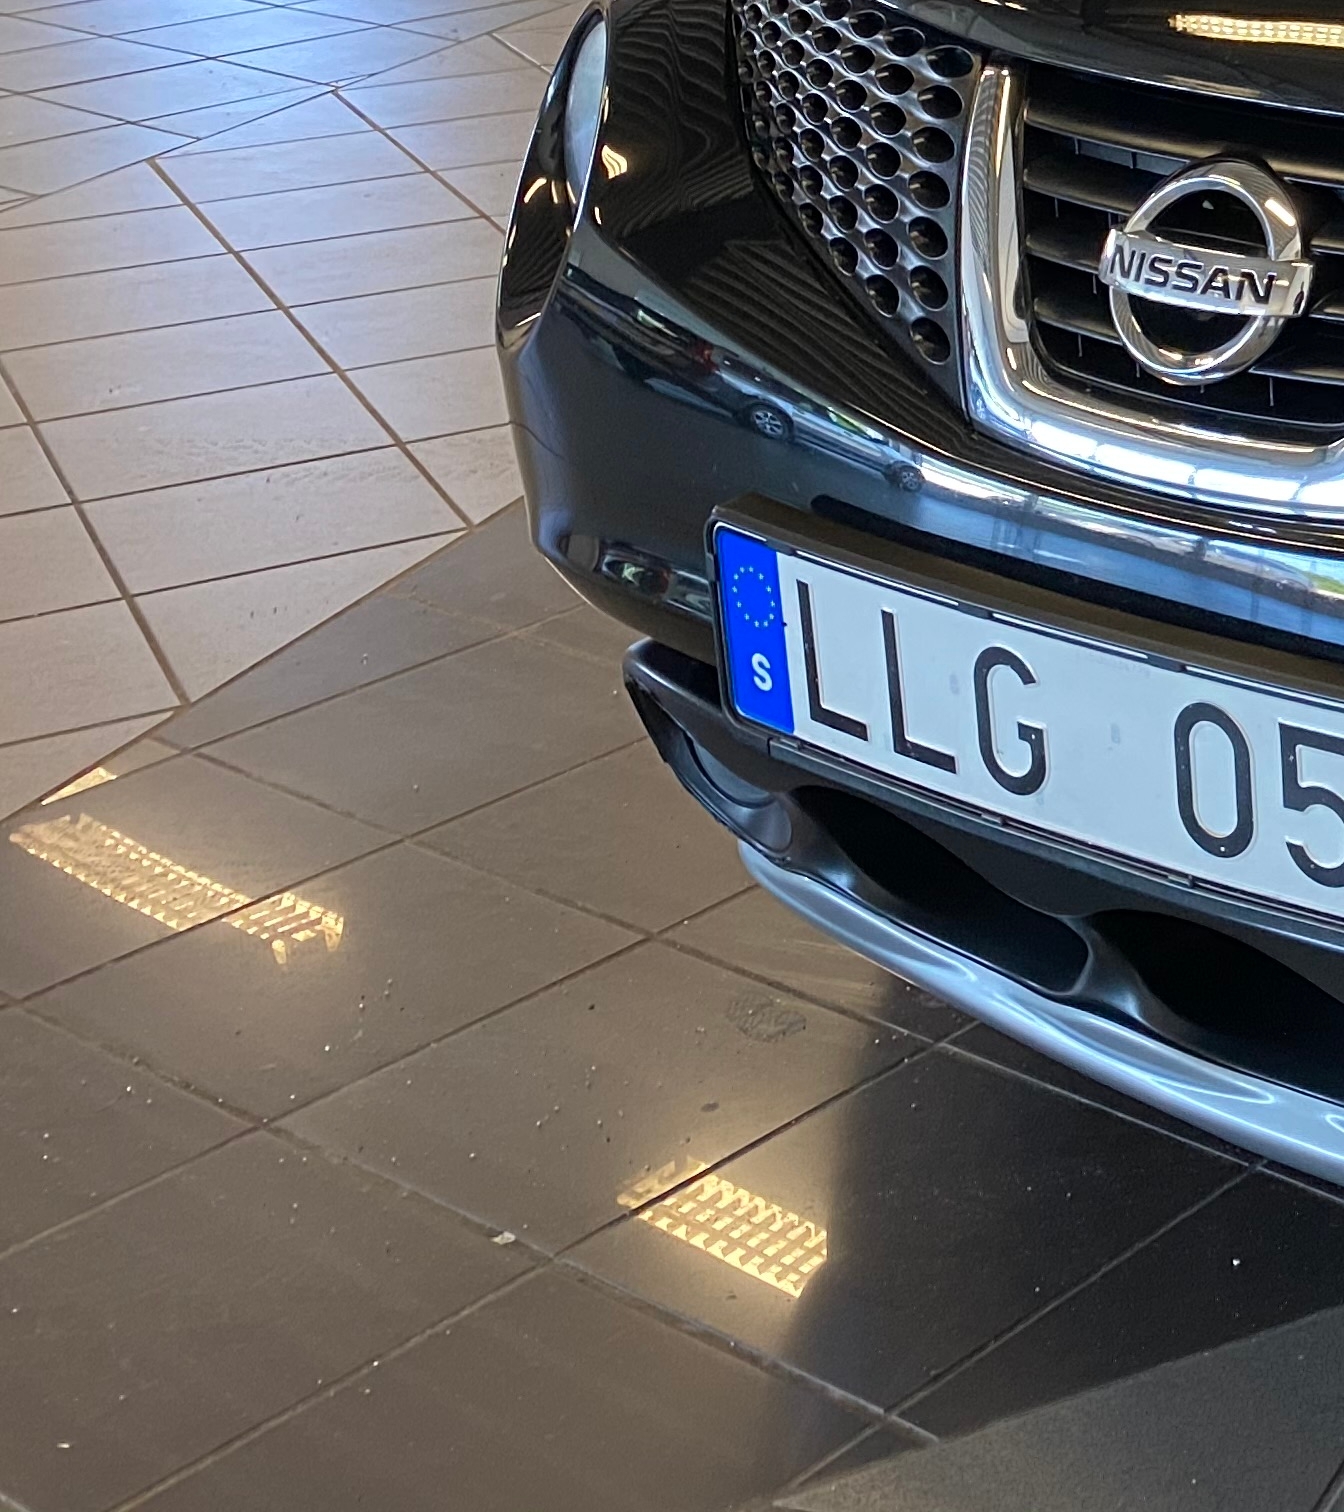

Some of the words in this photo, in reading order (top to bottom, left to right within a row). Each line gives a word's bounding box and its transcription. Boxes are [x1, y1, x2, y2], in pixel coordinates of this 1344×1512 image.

[1109, 243, 1277, 305] NISSAN
[751, 652, 773, 692] S
[796, 580, 1050, 796] LLG
